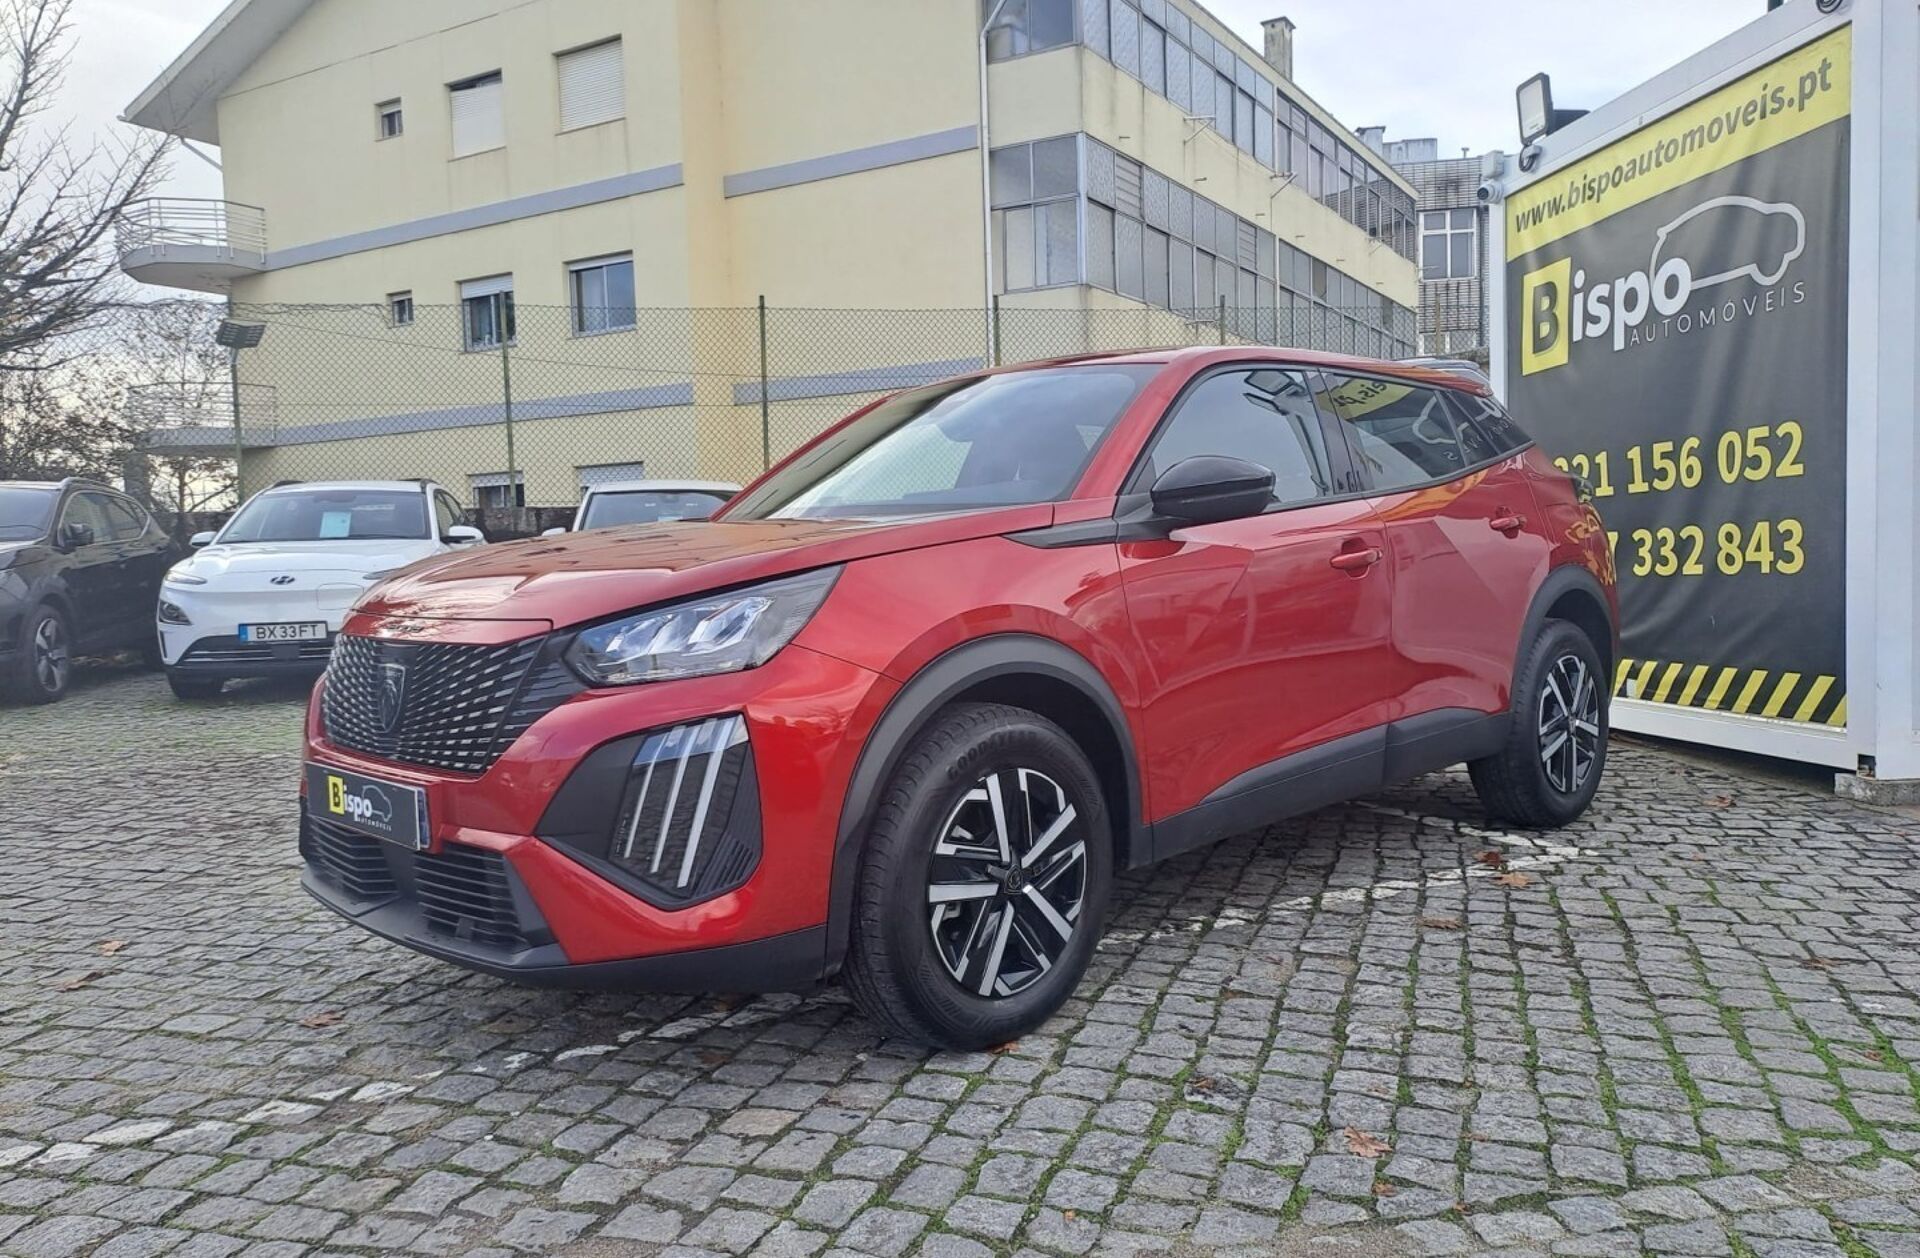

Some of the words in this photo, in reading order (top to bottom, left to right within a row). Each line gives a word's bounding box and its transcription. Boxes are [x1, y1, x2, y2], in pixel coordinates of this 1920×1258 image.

[1515, 57, 1833, 233] www.bispoautomoveis.pt
[1532, 257, 1692, 351] Bispo
[1630, 281, 1806, 347] AUTOMÓVEIS
[1627, 436, 1703, 494] 156
[1717, 421, 1804, 484] 052
[1631, 524, 1704, 577] 332
[1716, 518, 1805, 575] 843
[332, 782, 373, 821] Bispo
